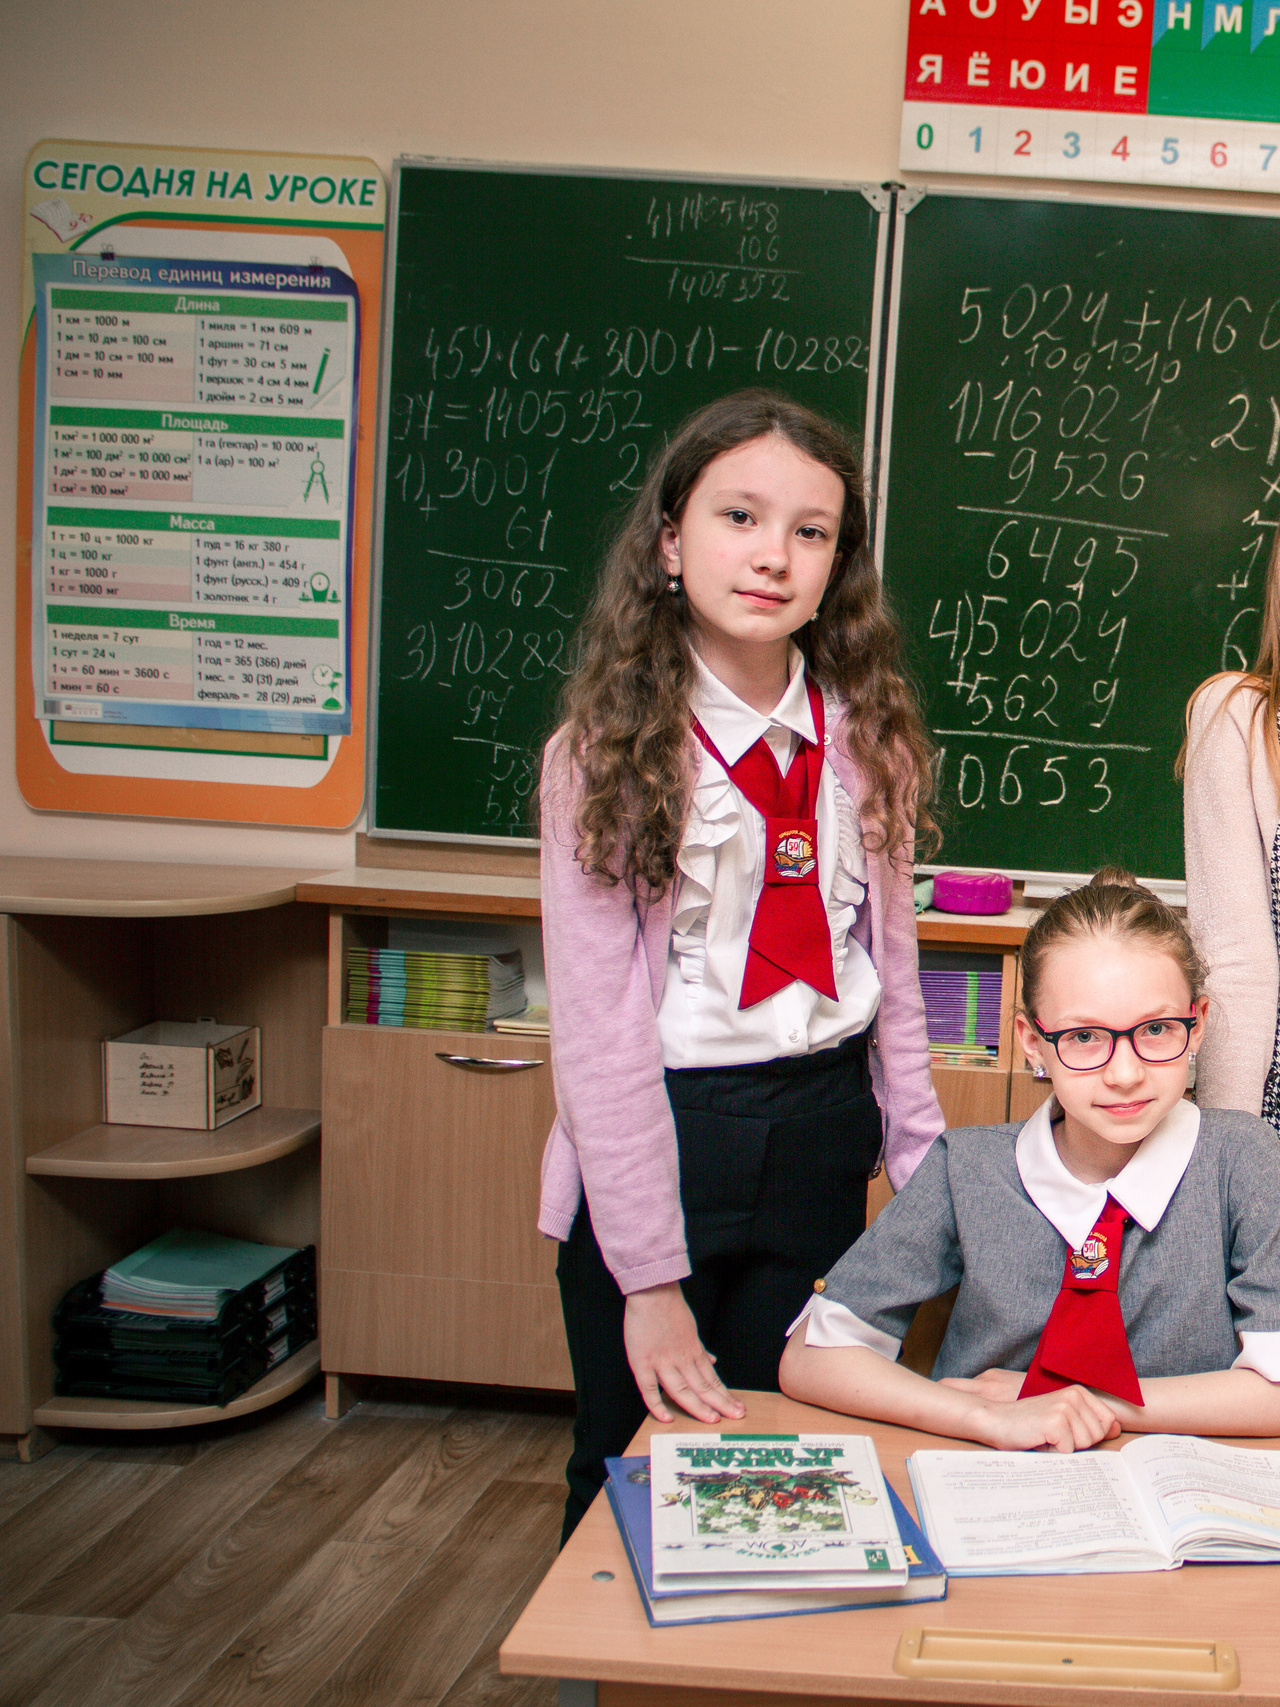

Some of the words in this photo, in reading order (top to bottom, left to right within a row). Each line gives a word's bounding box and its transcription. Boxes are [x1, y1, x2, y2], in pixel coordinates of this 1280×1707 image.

[920, 0, 946, 16] А
[969, 0, 997, 18] О
[1022, 0, 1041, 21] У
[1065, 0, 1098, 25] Ы
[1118, 0, 1143, 27] Э
[1166, 1, 1192, 30] Н
[1213, 3, 1243, 34] М
[917, 55, 943, 84] Я
[967, 52, 990, 87] Ё
[1010, 60, 1046, 90] Ю
[1065, 63, 1089, 92] И
[1114, 66, 1137, 95] Е
[916, 123, 934, 150] 0
[968, 126, 984, 154] 1
[1013, 129, 1033, 157] 2
[1062, 131, 1082, 159] 3
[1111, 135, 1131, 162] 4
[1160, 137, 1180, 165] 5
[1210, 141, 1228, 168] 6
[1259, 144, 1278, 171] 7
[33, 160, 196, 198] СЕГОДНЯ
[205, 171, 253, 199] НА
[265, 173, 377, 207] УРОКЕ
[72, 259, 152, 282] Перевод
[157, 267, 224, 286] единиц
[230, 271, 332, 290] измерения
[174, 296, 220, 313] Длина
[95, 315, 119, 327] 1000
[208, 322, 236, 331] миля
[279, 323, 300, 335] 609
[208, 340, 244, 351] аршин
[207, 355, 228, 368] фут
[243, 357, 257, 368] 30
[206, 375, 244, 386] вершок
[206, 390, 236, 403] дюйм
[161, 413, 229, 432] Площадь
[218, 437, 259, 452] (гектар)
[214, 455, 235, 468] (ар)
[248, 457, 265, 468] 100
[169, 514, 216, 531] Масса
[203, 541, 222, 551] пуд
[262, 541, 282, 552] 380
[203, 556, 230, 569] фунт
[232, 557, 265, 571] (англ.)
[278, 559, 298, 571] 454
[84, 566, 109, 579] 1000
[203, 574, 228, 586] фунт
[230, 574, 269, 588] (русск.)
[281, 577, 301, 588] 409
[203, 592, 250, 604] золотник
[168, 613, 216, 631] Время
[60, 631, 99, 642] неделя
[122, 634, 140, 645] сут
[204, 639, 222, 650] год
[247, 642, 269, 651] мес.
[92, 647, 106, 659] 24
[204, 657, 222, 667] год
[234, 655, 252, 667] 365
[255, 656, 280, 670] (366)
[282, 660, 307, 670] дней
[98, 668, 120, 678] мин
[134, 667, 160, 680] 3600
[204, 674, 225, 683] мес.
[241, 673, 254, 684] 30
[256, 673, 273, 687] (31)
[275, 676, 299, 687] дней
[197, 689, 240, 701] февраль
[256, 691, 268, 702] 28
[271, 691, 290, 704] (29)
[292, 694, 317, 705] дней
